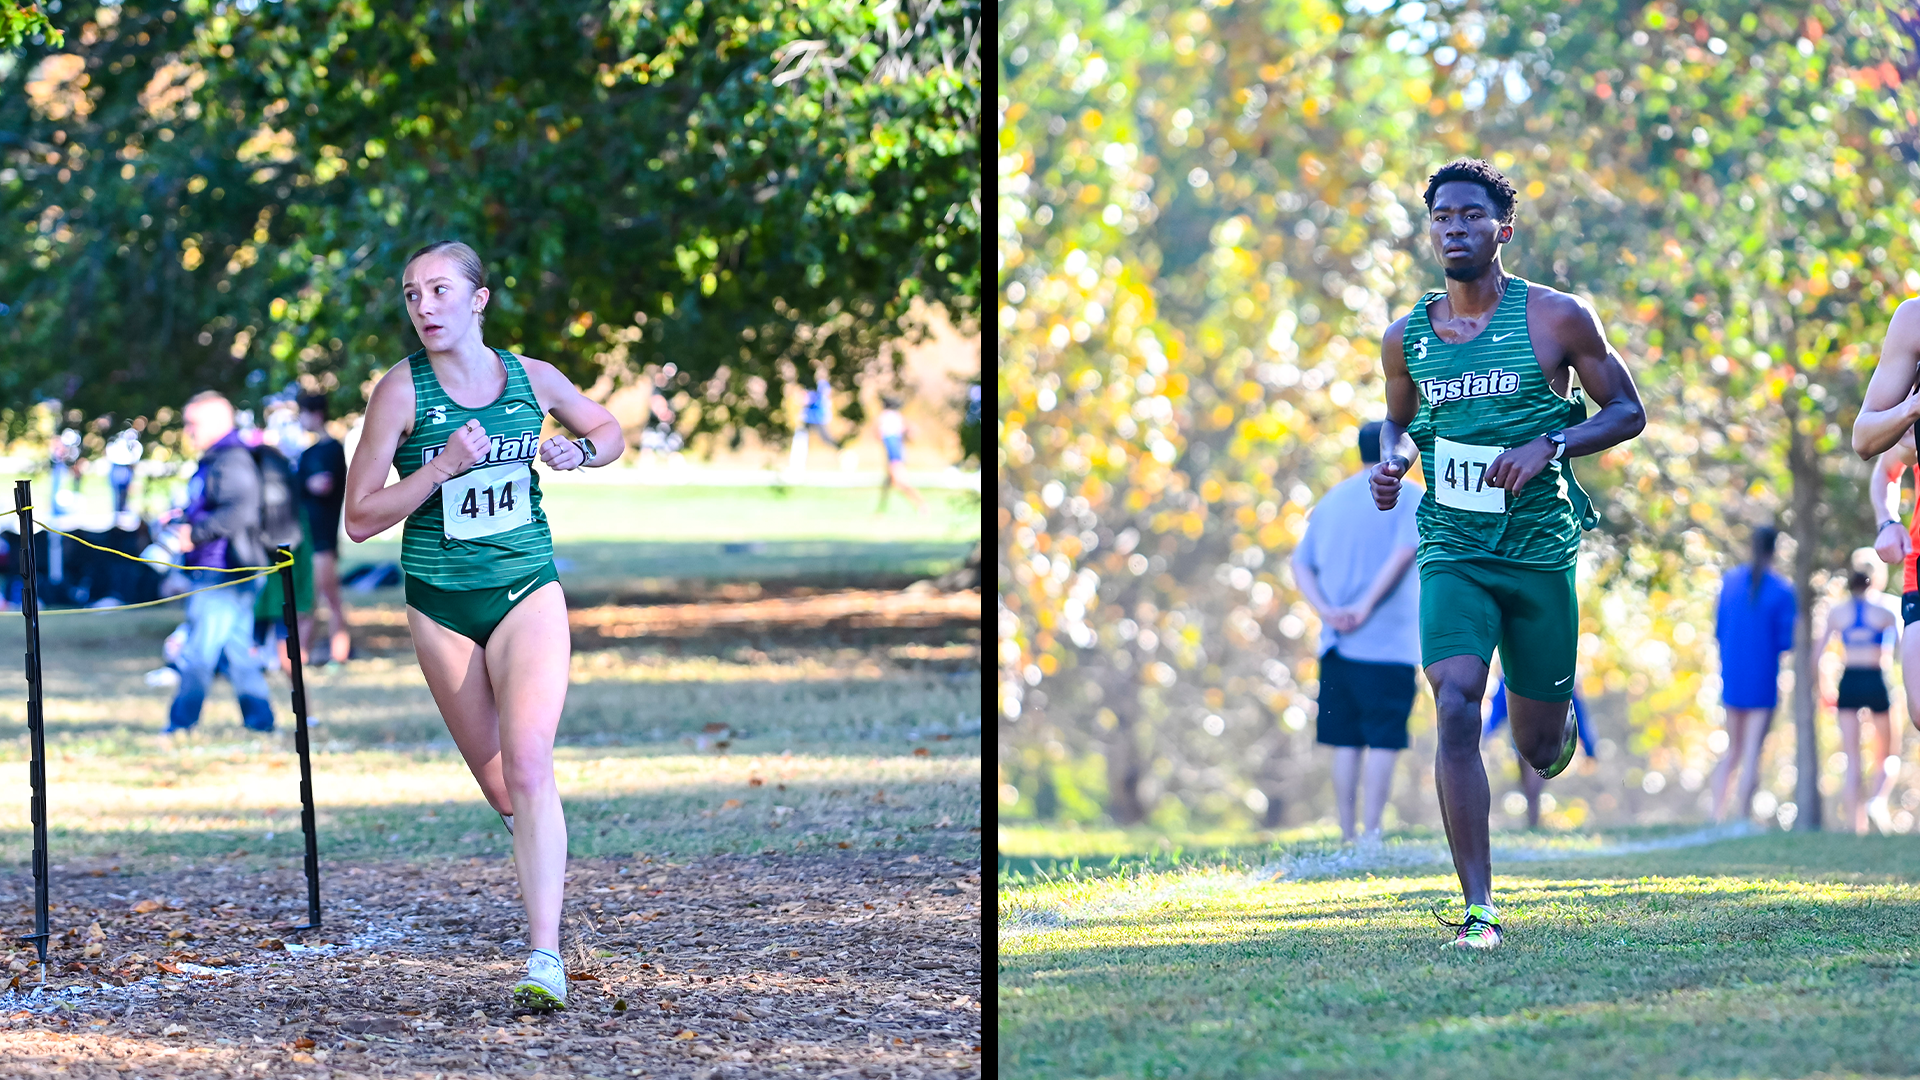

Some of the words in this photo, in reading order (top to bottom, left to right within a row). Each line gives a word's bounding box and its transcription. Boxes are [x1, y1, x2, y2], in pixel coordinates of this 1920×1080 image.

[1419, 369, 1520, 408] Upstate
[1445, 457, 1488, 493] 417
[461, 481, 515, 519] 414
